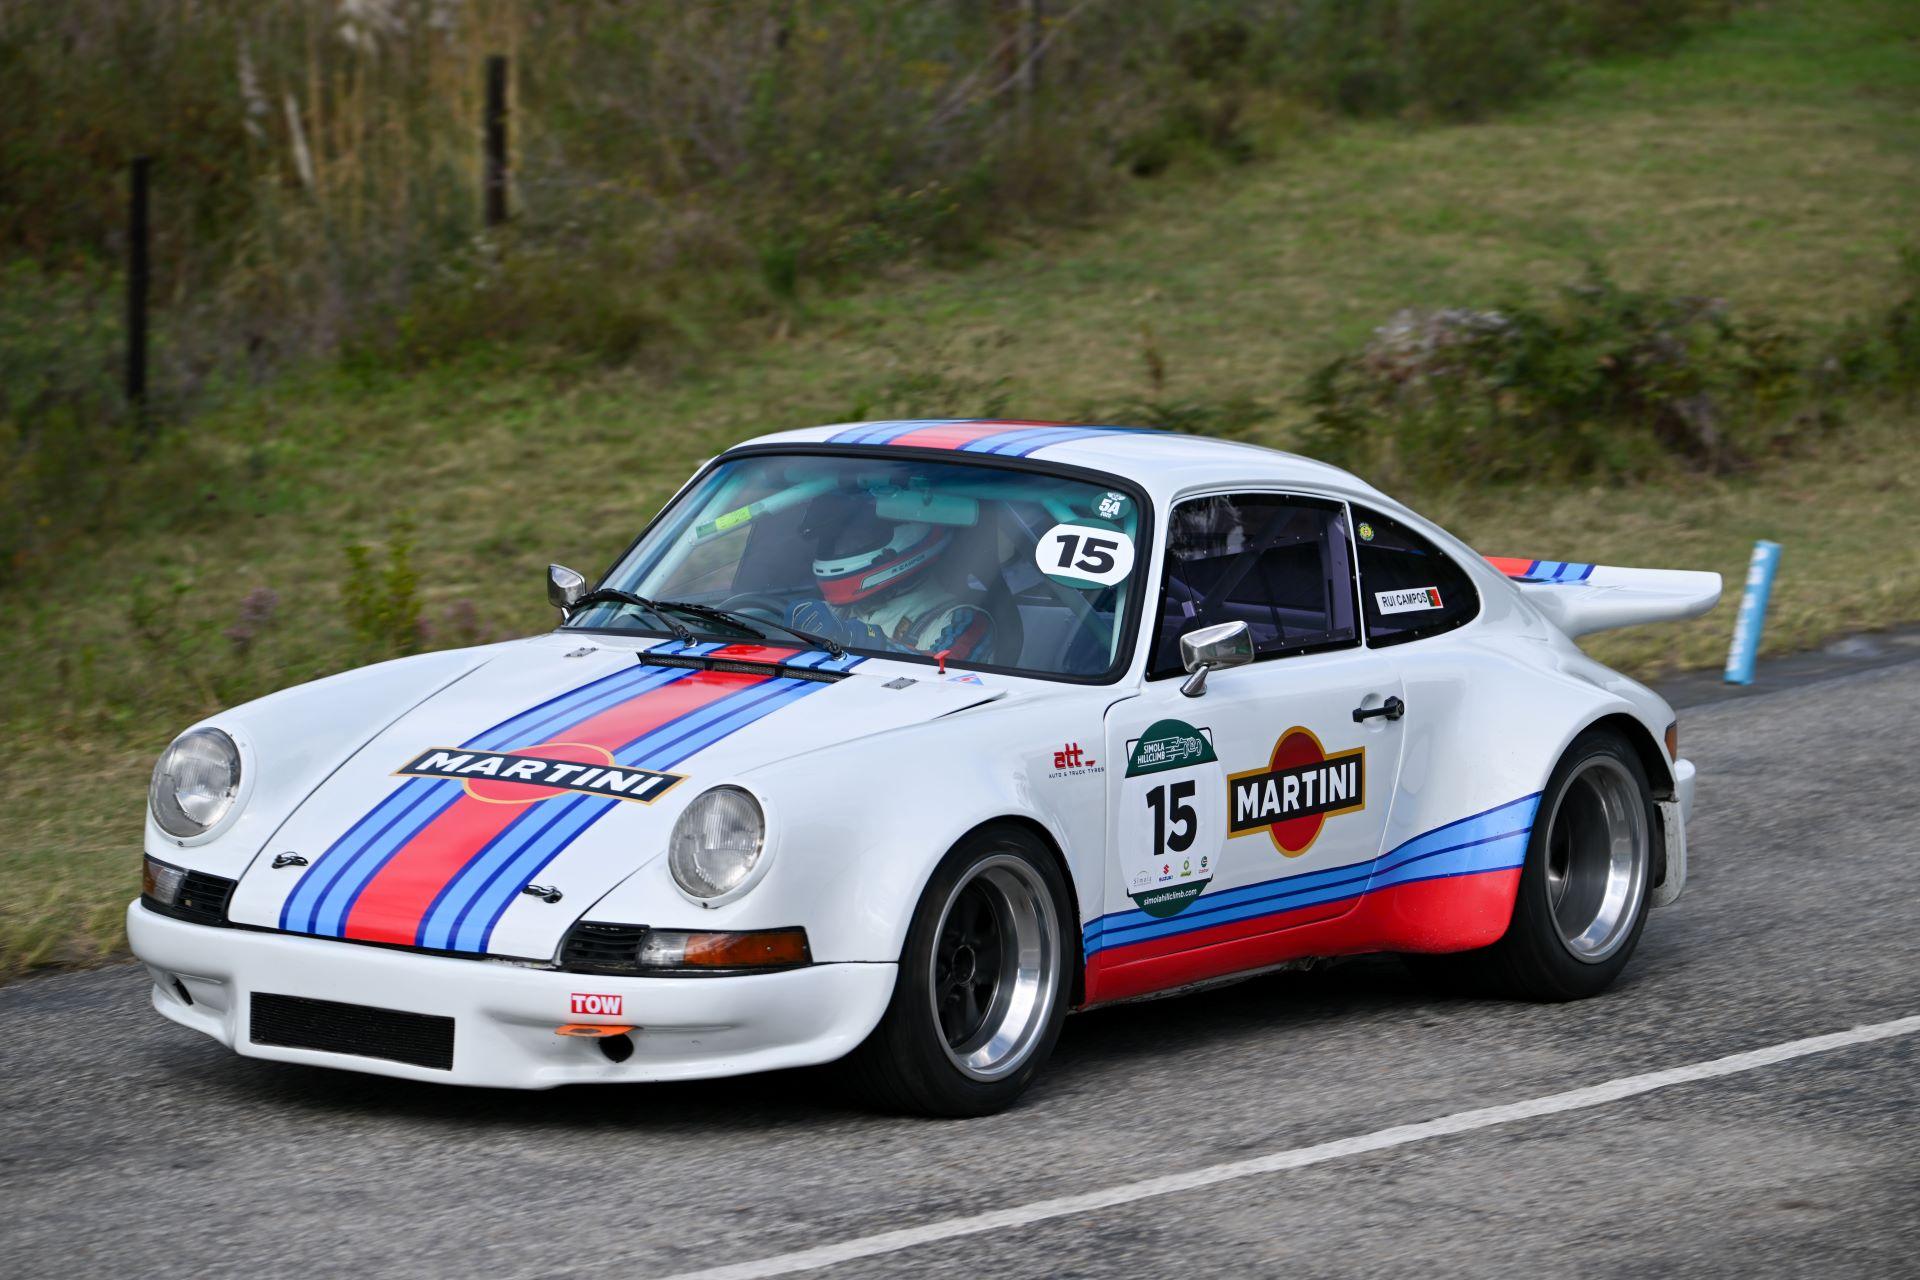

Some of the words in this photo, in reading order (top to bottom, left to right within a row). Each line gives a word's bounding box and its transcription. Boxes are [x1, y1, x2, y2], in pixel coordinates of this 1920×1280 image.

[1099, 498, 1120, 515] 5A
[1057, 534, 1119, 574] 15
[1381, 595, 1396, 607] RUI
[1396, 592, 1428, 606] CAMPOS
[1143, 742, 1165, 754] SIMOLA
[1137, 751, 1166, 765] HILLCLIMB
[415, 752, 664, 795] MARTINI
[1237, 762, 1356, 822] MARTINI
[1146, 780, 1197, 856] 15
[1143, 888, 1197, 906] simolahillclimb.com
[572, 995, 620, 1014] TOW
